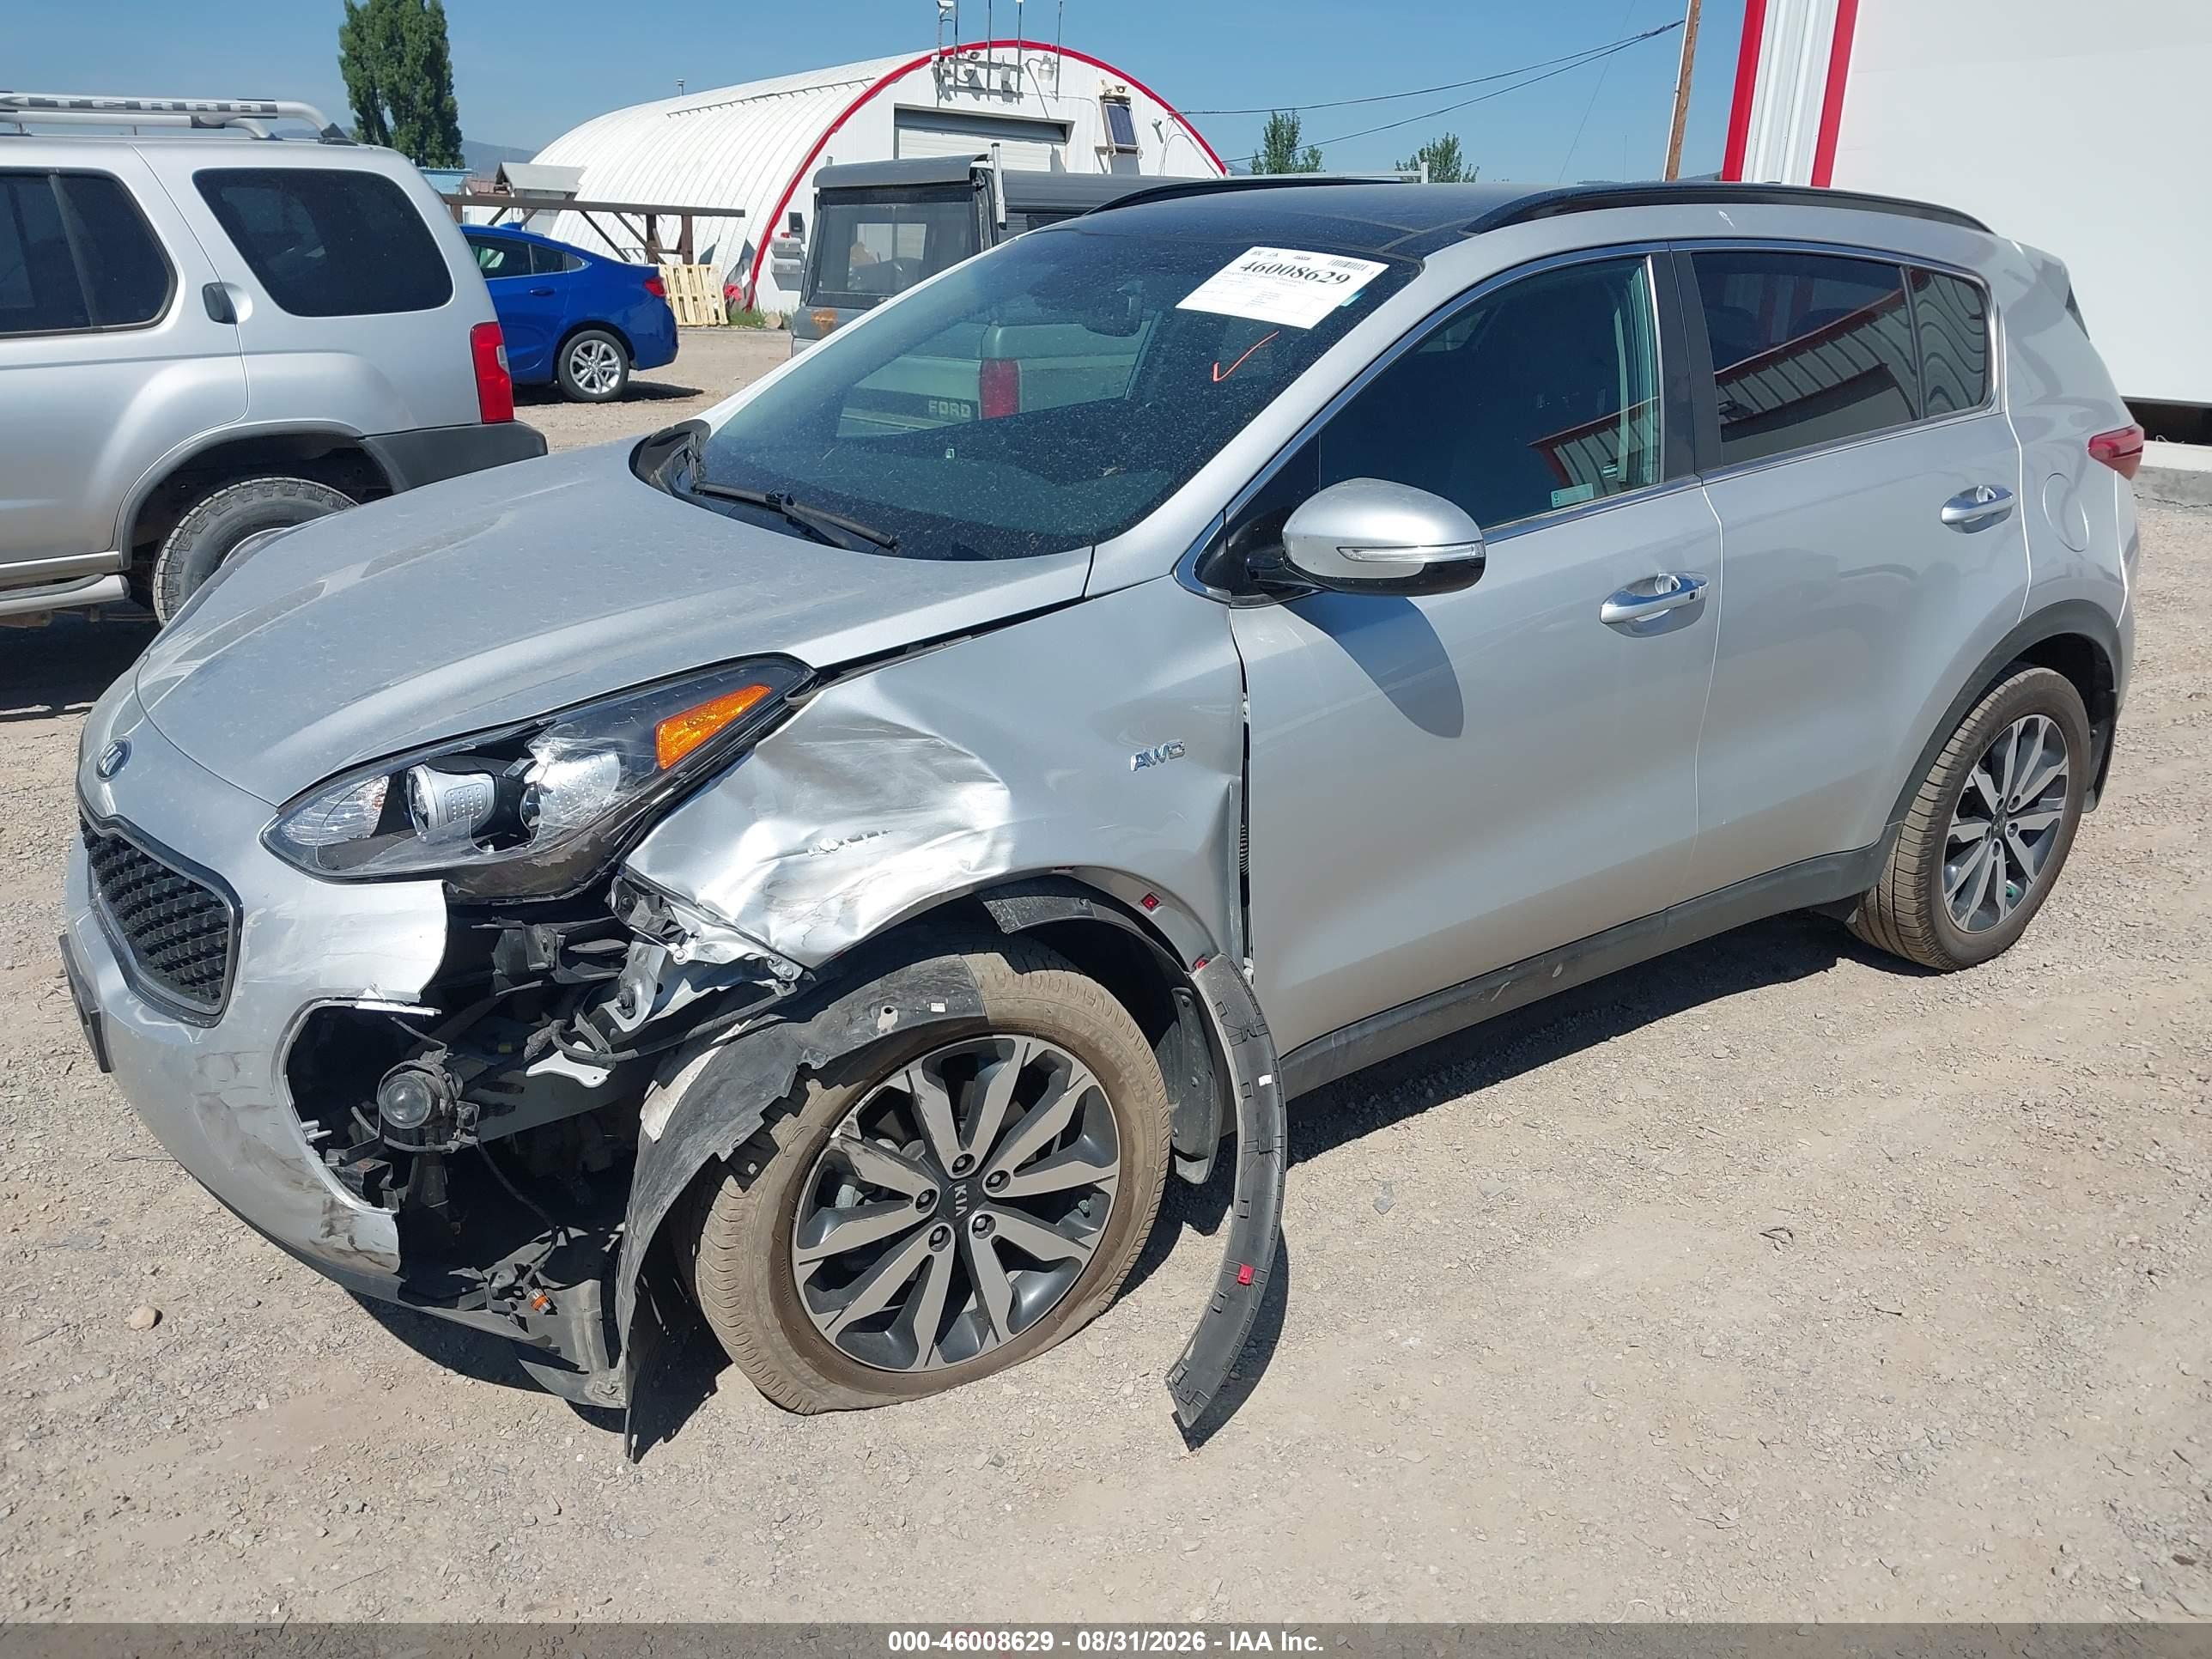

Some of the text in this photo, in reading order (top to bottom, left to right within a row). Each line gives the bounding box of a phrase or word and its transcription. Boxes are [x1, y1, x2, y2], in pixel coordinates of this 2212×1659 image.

[1240, 260, 1352, 285] 46008629
[928, 399, 972, 419] FORD
[1130, 739, 1186, 772] AWD
[954, 1183, 968, 1218] KIA
